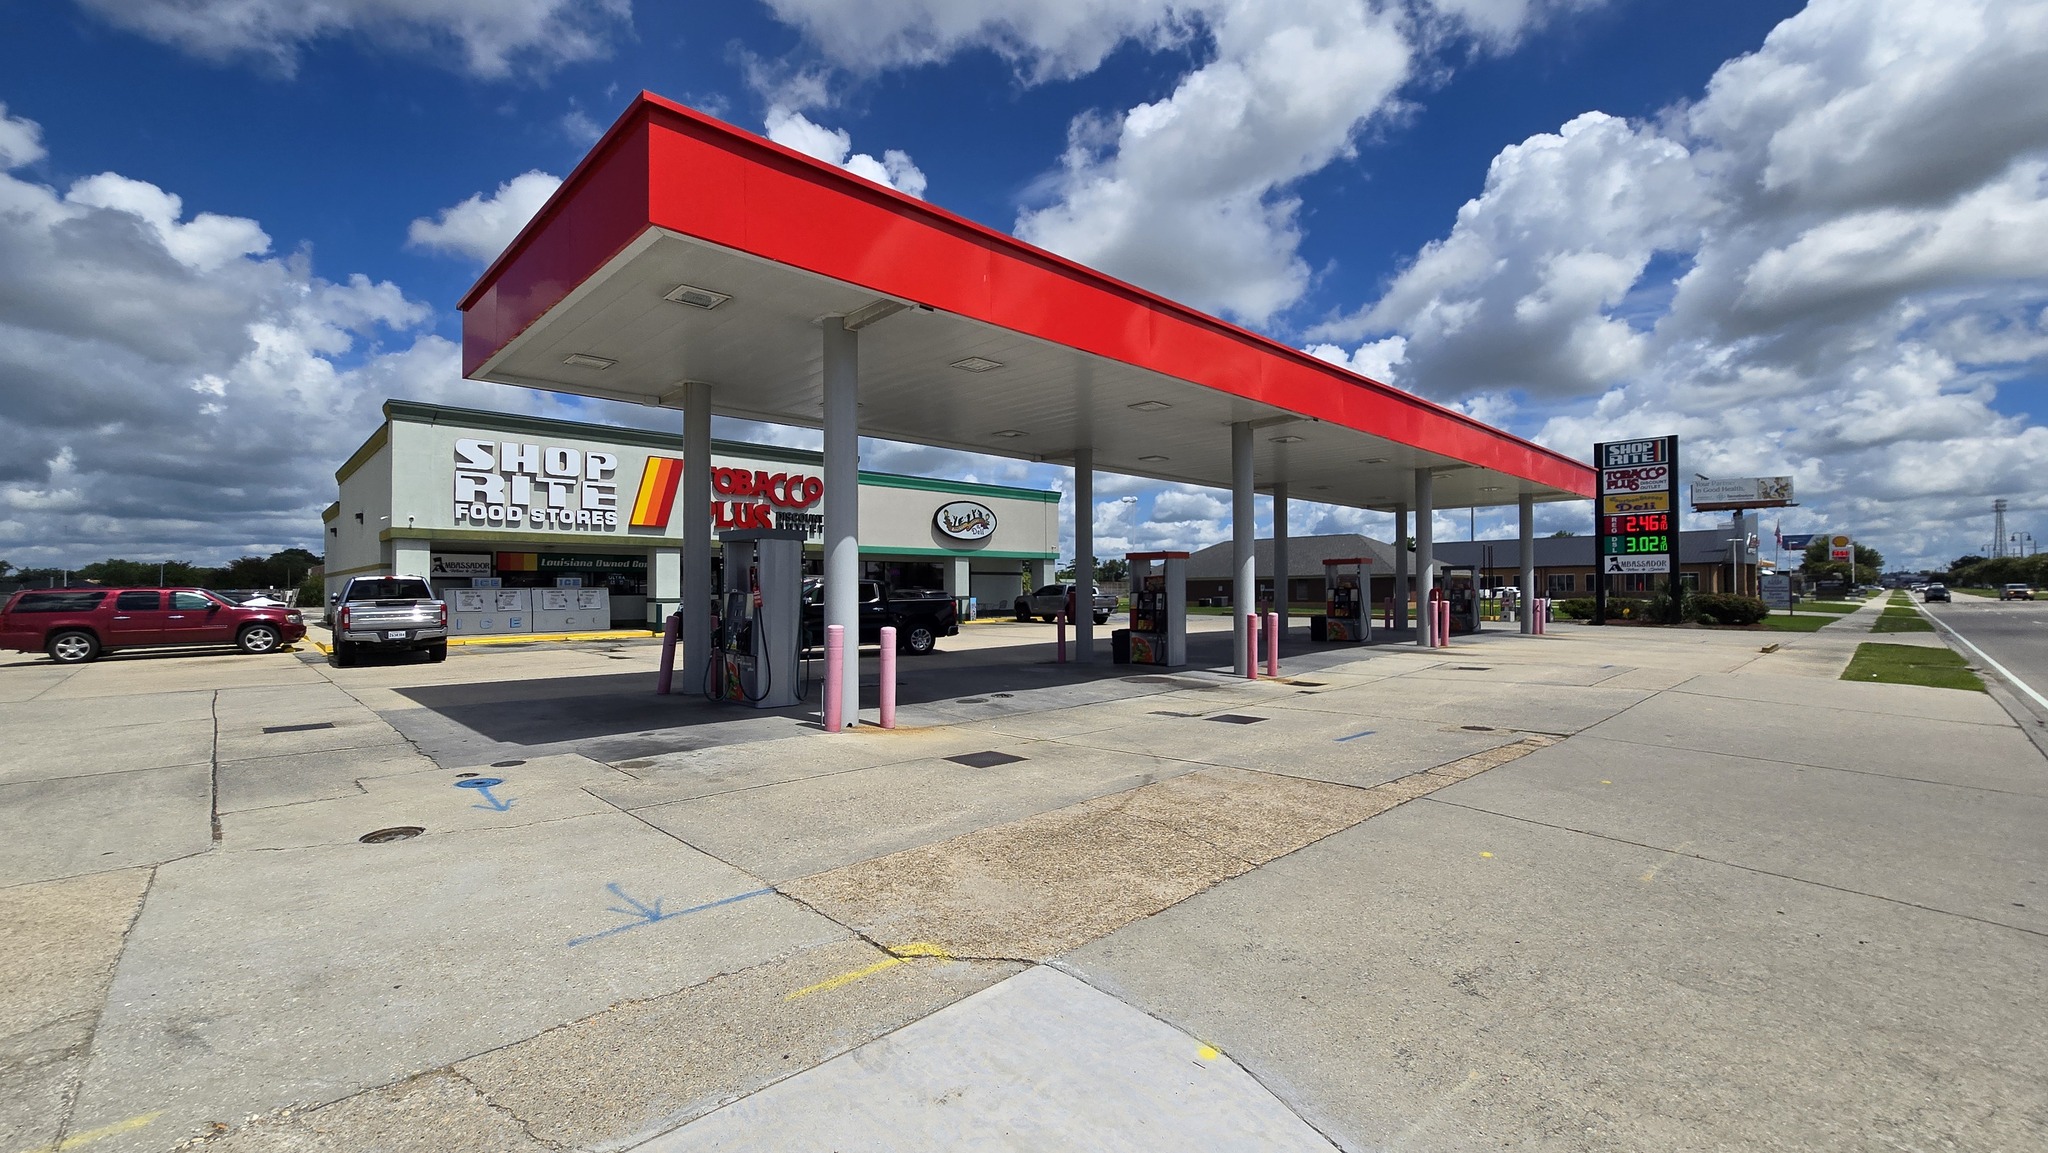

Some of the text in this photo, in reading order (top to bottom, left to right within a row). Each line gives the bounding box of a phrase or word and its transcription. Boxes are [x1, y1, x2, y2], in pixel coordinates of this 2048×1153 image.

[1609, 442, 1653, 454] SHOP
[455, 438, 618, 480] SHOP
[1609, 452, 1654, 465] RITE
[1605, 466, 1667, 480] TOBACCO
[455, 471, 618, 510] RITE
[1606, 479, 1640, 491] PLUS
[1615, 501, 1657, 511] Deli
[455, 503, 618, 525] FOOD STORES
[776, 512, 824, 524] DISCOUNT
[1626, 515, 1659, 532] 2.46
[1626, 536, 1659, 552] 3.02
[541, 558, 593, 567] Louisiana
[595, 559, 631, 568] Owned
[473, 579, 500, 587] ICE
[559, 579, 582, 587] ICE
